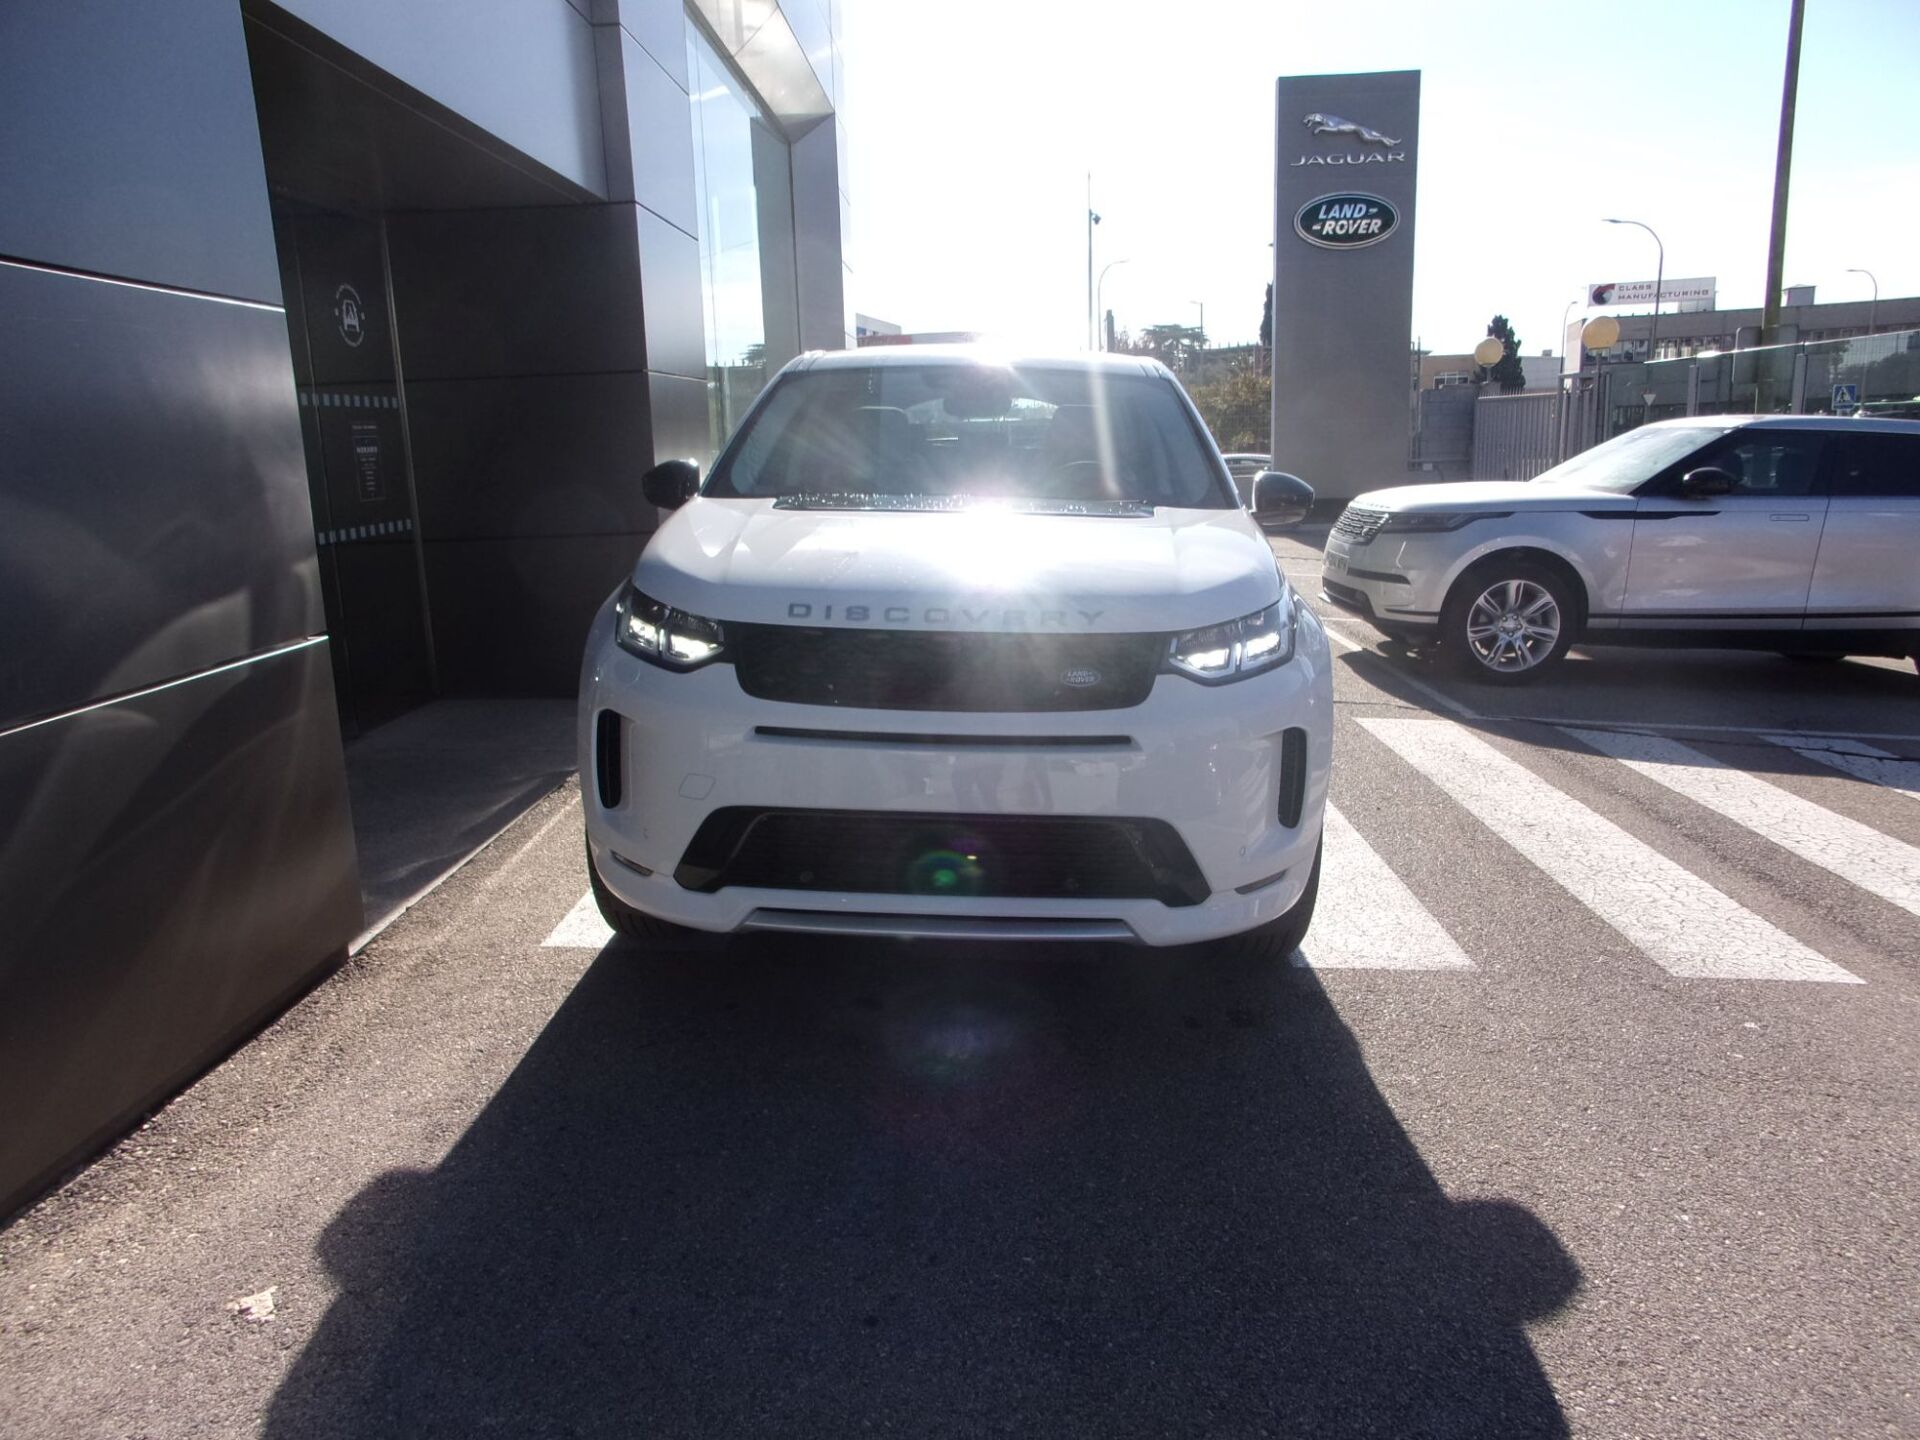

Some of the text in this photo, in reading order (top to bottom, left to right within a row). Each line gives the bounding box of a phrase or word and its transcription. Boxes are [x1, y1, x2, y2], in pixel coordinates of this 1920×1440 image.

[1290, 152, 1405, 166] JAGUAR
[1318, 204, 1366, 219] LAND
[1322, 219, 1382, 235] ROVER
[1618, 283, 1652, 292] CLASS
[788, 602, 1105, 626] DISCOVERY
